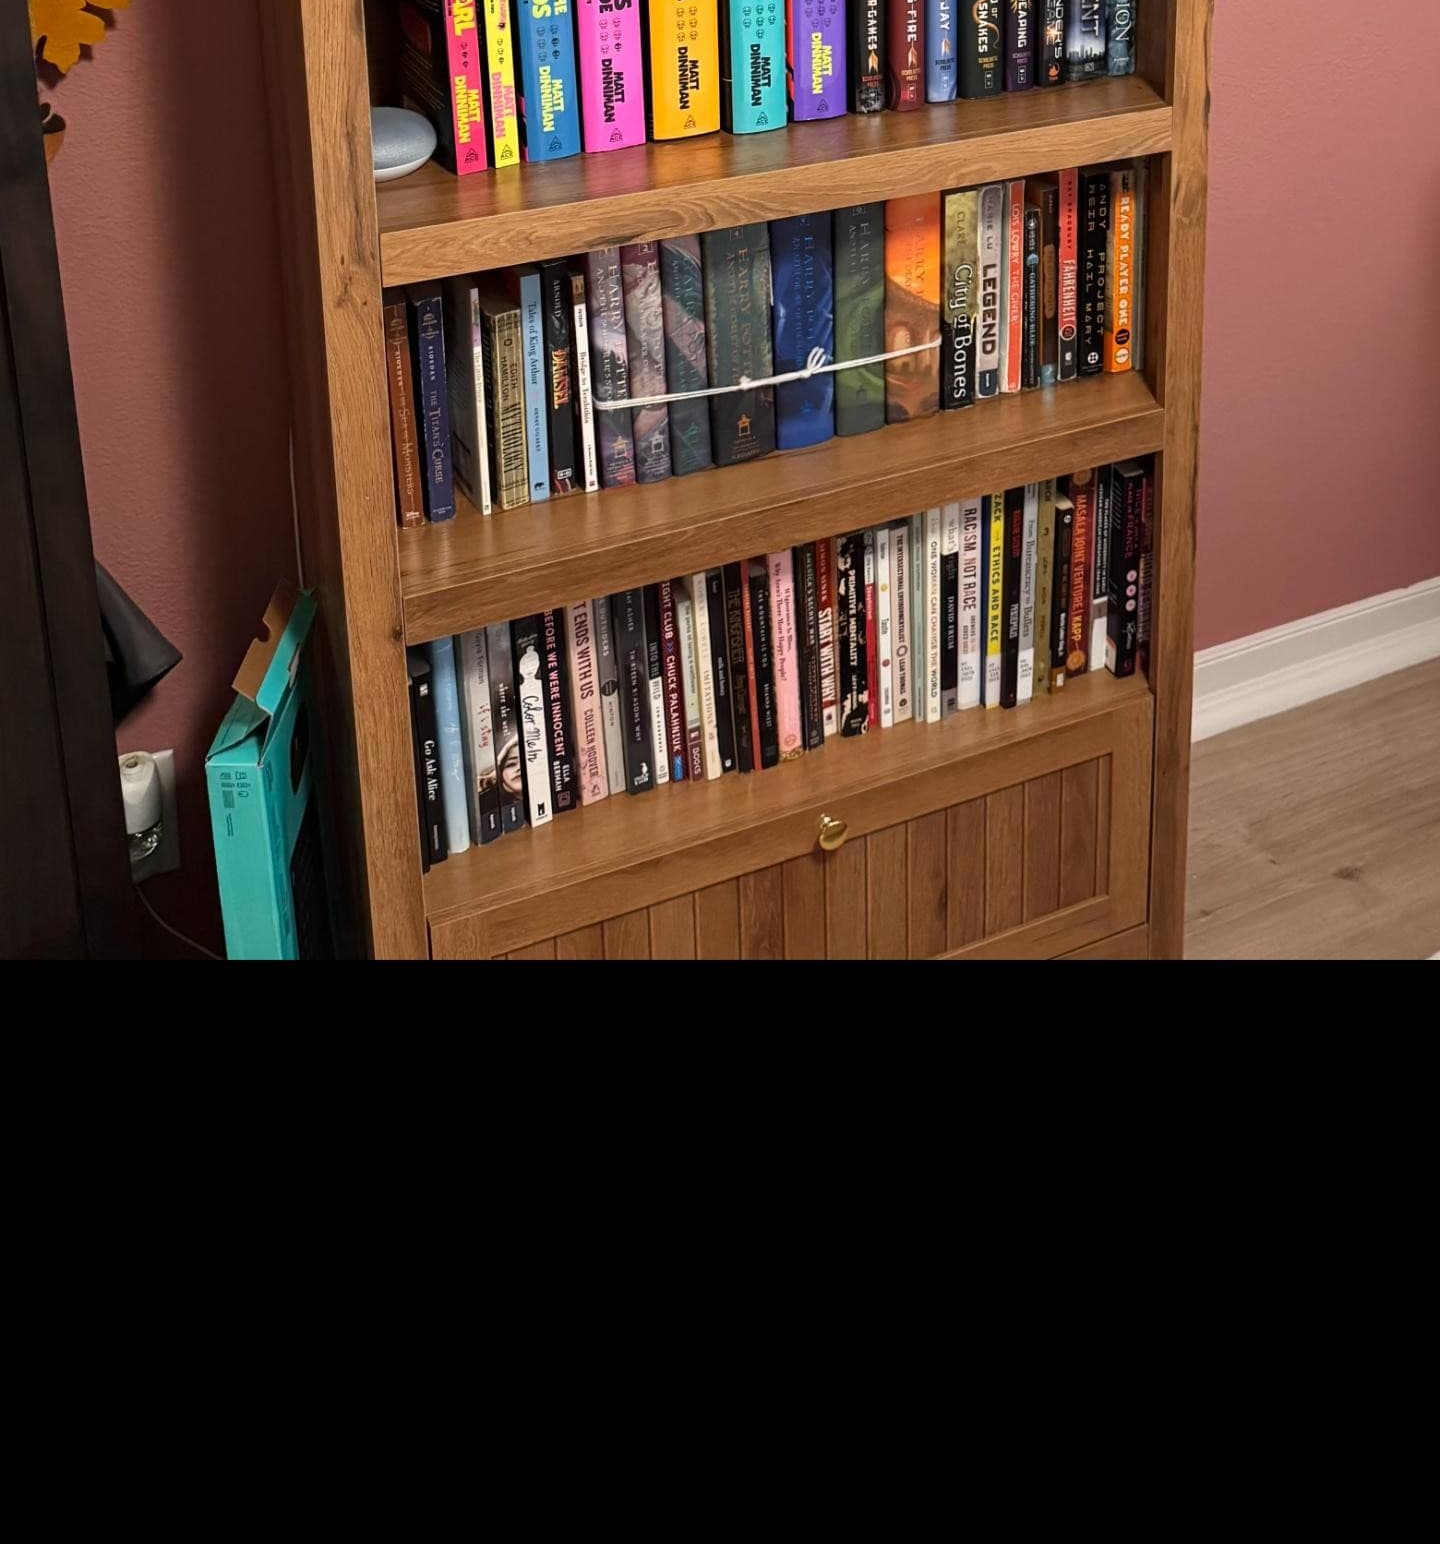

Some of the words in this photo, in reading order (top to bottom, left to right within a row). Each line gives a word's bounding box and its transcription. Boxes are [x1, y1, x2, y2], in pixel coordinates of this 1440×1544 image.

[908, 10, 916, 42] FIRE
[613, 71, 625, 103] MATT
[677, 47, 689, 109] DINNIMAN
[688, 60, 699, 90] MATT
[750, 44, 762, 106] DINNIMAN
[761, 56, 771, 87] MATT
[469, 88, 480, 122] MATT
[601, 58, 615, 123] DINNIMAN
[455, 76, 470, 144] DINNIMAN
[1121, 197, 1130, 240] READY
[1119, 245, 1129, 295] PLAYER
[949, 264, 973, 309] City
[528, 301, 537, 323] Tales
[957, 314, 971, 329] of
[982, 264, 997, 355] LEGEND
[1119, 299, 1128, 326] ONE
[529, 325, 538, 334] of
[528, 336, 539, 357] King
[501, 357, 509, 400] HAMILTON
[530, 358, 541, 385] Arthur
[953, 335, 973, 399] Bones
[963, 557, 977, 582] NOT
[992, 546, 1000, 584] ETHICS
[963, 583, 977, 611] RACE
[544, 610, 556, 651] BEFORE
[575, 612, 590, 646] ENDS
[664, 611, 673, 639] CLUB
[819, 607, 832, 645] START
[990, 613, 999, 642] RACE
[547, 653, 557, 670] WE
[576, 648, 592, 681] WITH
[665, 656, 676, 692] CHUCK
[821, 644, 833, 673] WITH
[549, 672, 560, 699] WERE
[581, 683, 593, 699] US
[822, 674, 835, 700] WHY
[552, 701, 565, 756] INNOCENT
[668, 693, 681, 751] PALAHNIUK
[424, 740, 435, 755] Go
[425, 757, 434, 775] Ask
[553, 761, 562, 792] BERMAN
[426, 775, 439, 800] Alice
